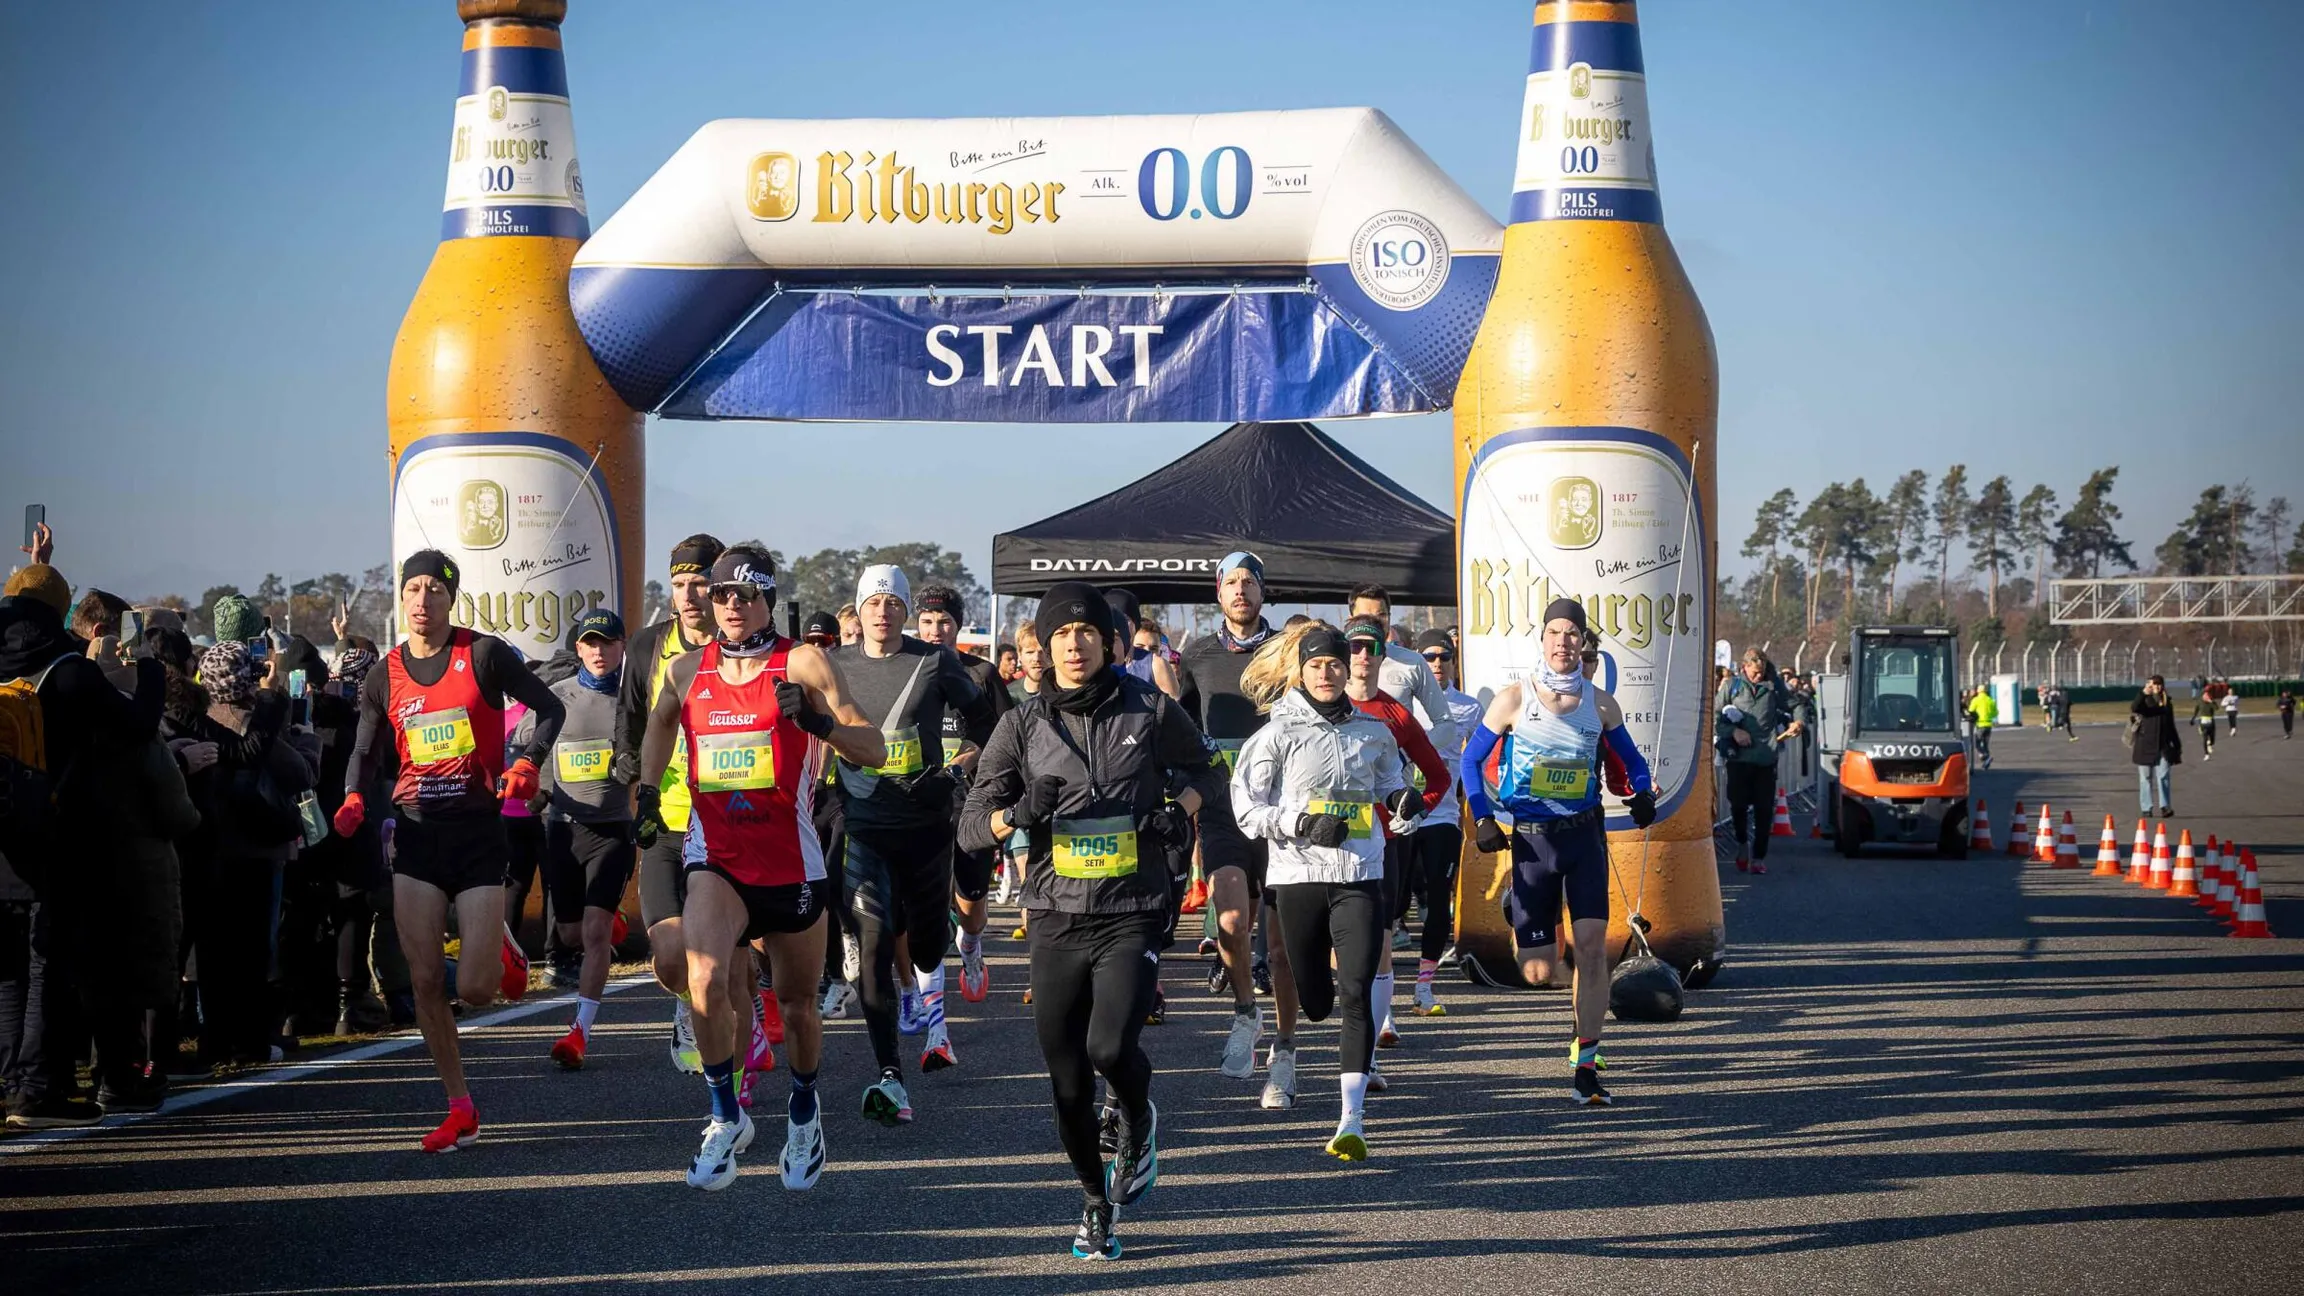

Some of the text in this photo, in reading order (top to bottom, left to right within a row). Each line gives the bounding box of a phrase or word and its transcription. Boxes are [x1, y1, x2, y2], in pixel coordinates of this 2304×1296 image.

[1530, 104, 1632, 145] Bburger
[454, 127, 548, 165] Biurger
[950, 139, 1048, 168] Bitte ein Bit
[1561, 146, 1598, 173] 0.0
[480, 165, 514, 192] 0.0
[1091, 177, 1121, 190] Alk.
[1138, 146, 1253, 221] 0.0
[811, 150, 1066, 235] Bitburger
[1561, 192, 1598, 208] PILS
[479, 210, 513, 226] PILS
[1388, 214, 1408, 223] VOM
[1409, 216, 1442, 257] DEUTSCHEN
[1373, 240, 1426, 267] ISO
[925, 324, 1164, 387] START
[517, 495, 543, 504] 1817
[1612, 493, 1638, 502] 1817
[502, 545, 591, 576] Bitte ein Bit
[1595, 544, 1682, 578] Bitte ein Bit
[583, 616, 609, 627] BOSS
[708, 710, 757, 726] Teusser
[422, 724, 455, 744] 1010
[433, 743, 450, 752] ELIAS
[885, 742, 905, 759] 17
[1871, 744, 1943, 758] TOYOTA
[570, 752, 601, 767] 1063
[712, 749, 755, 770] 1006
[719, 771, 749, 780] DOMINIK
[1546, 769, 1576, 784] 1016
[1070, 835, 1118, 857] 1005
[1084, 859, 1105, 867] SETH
